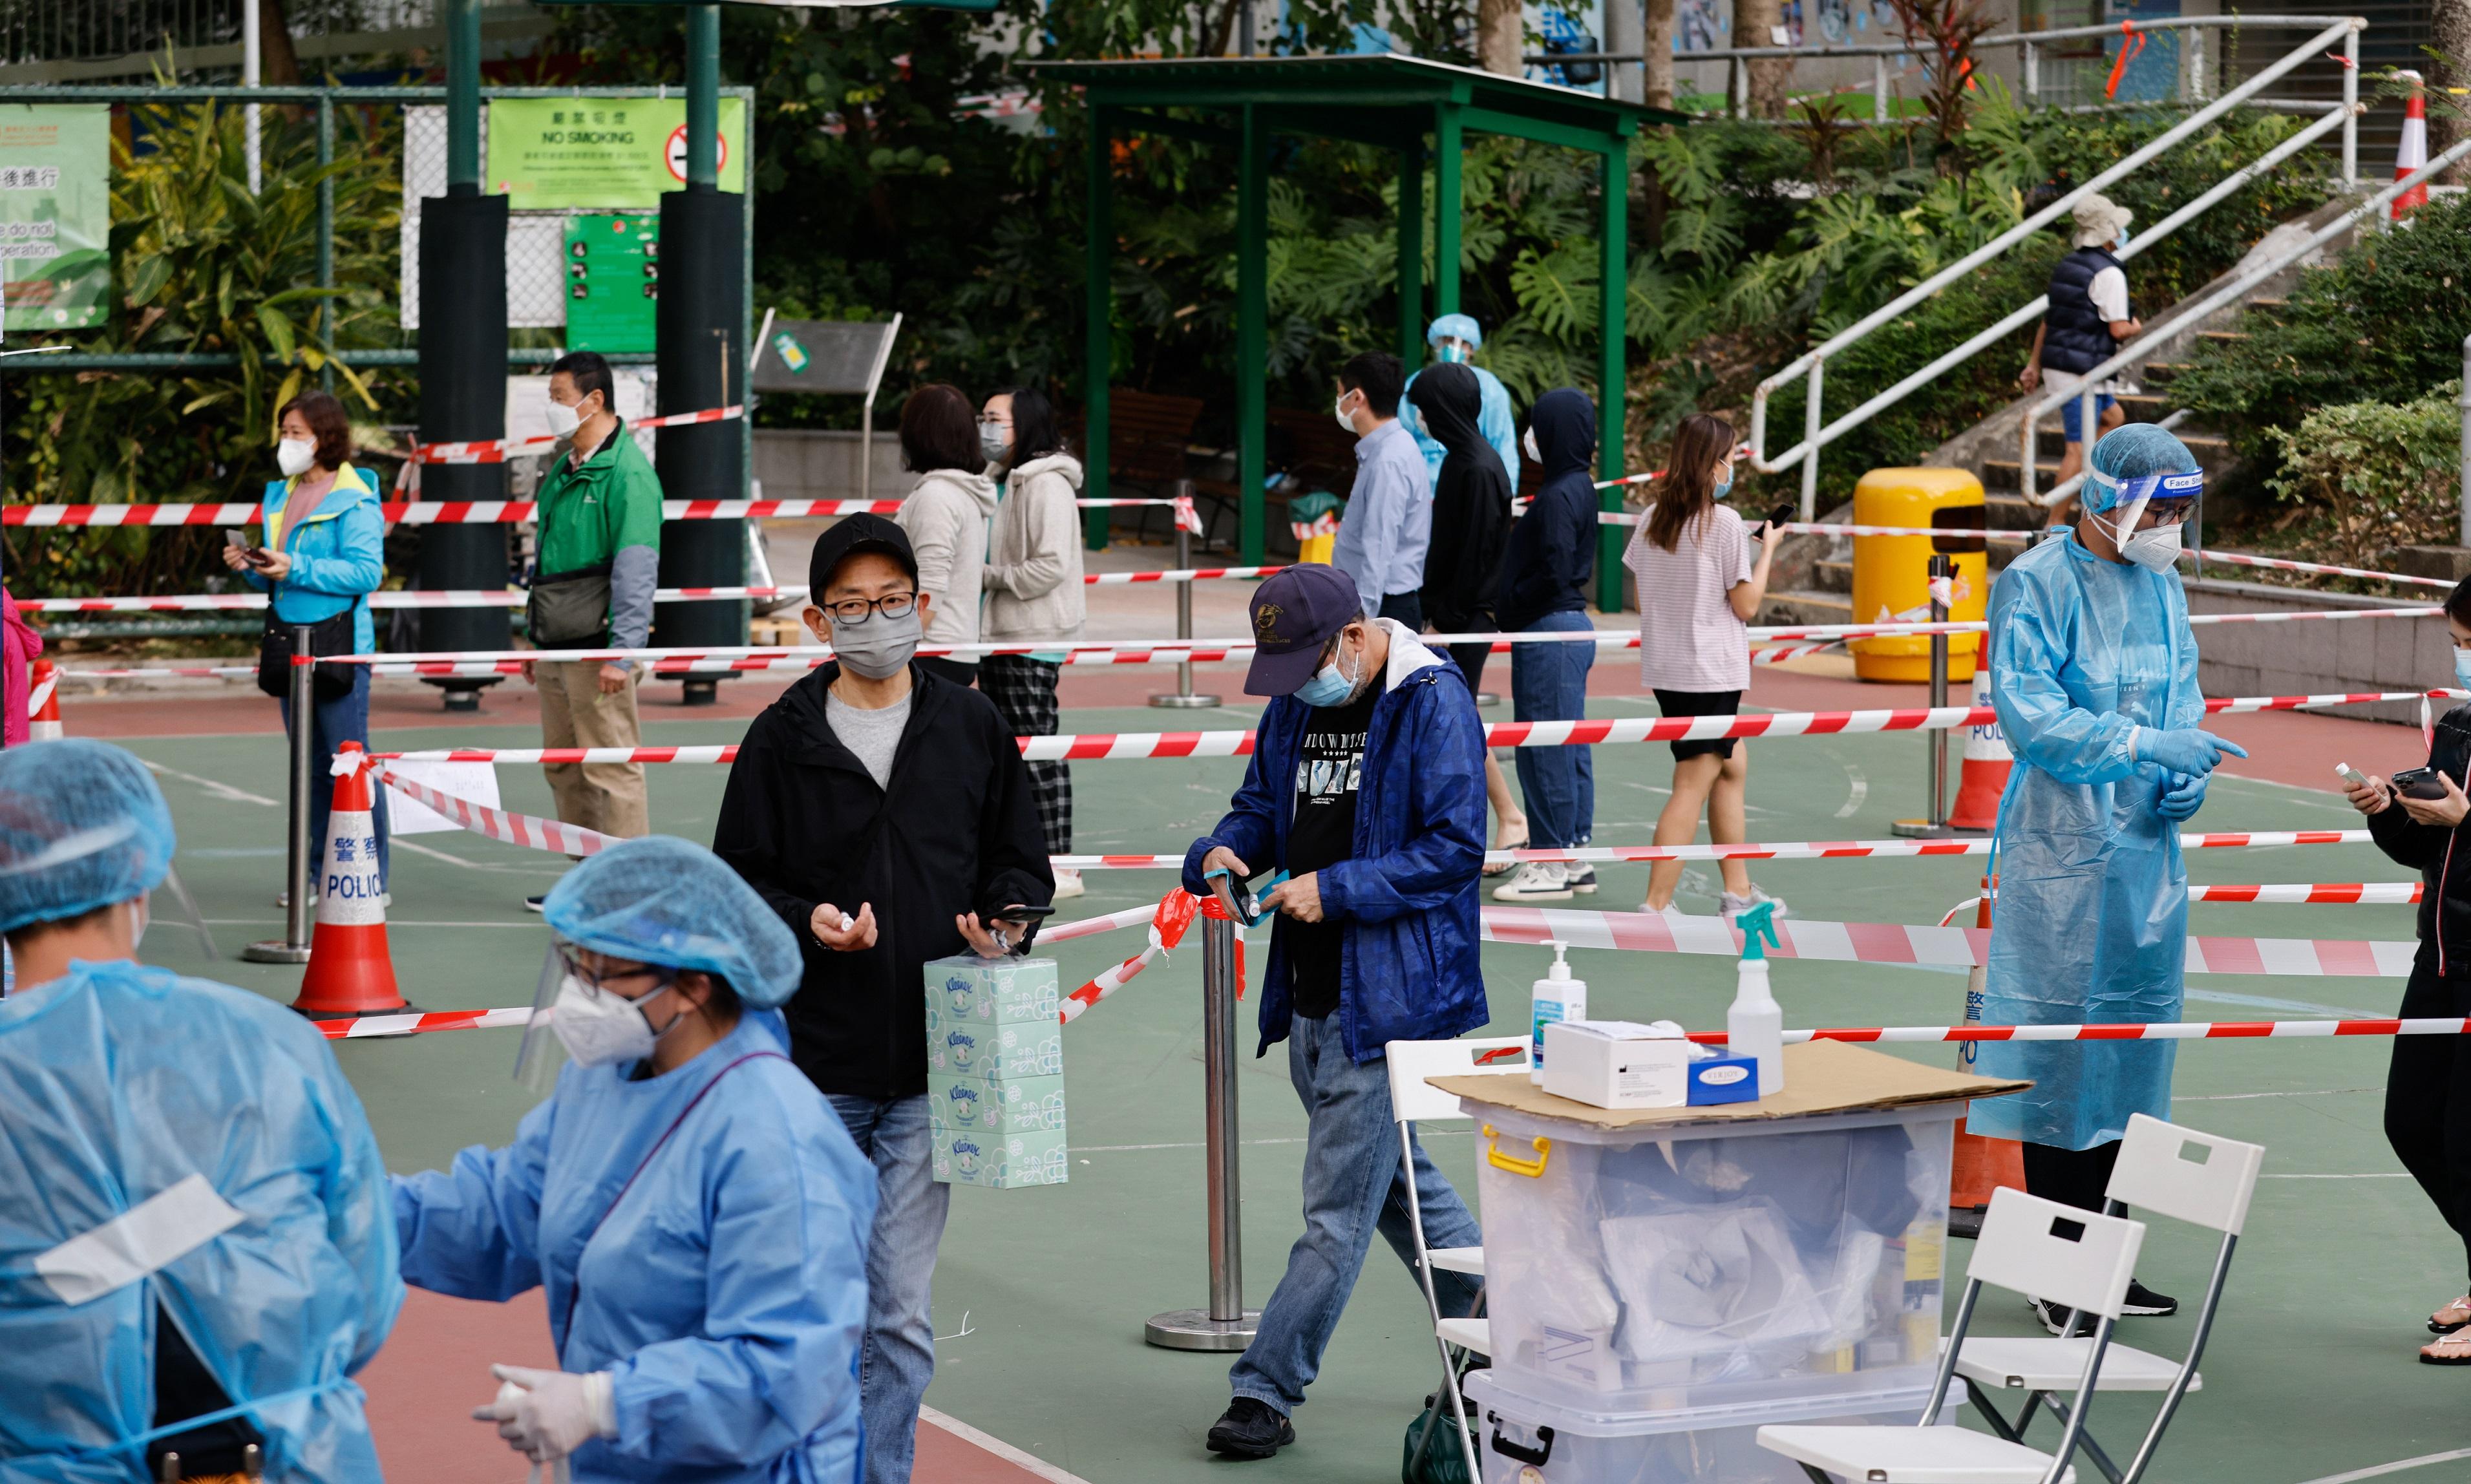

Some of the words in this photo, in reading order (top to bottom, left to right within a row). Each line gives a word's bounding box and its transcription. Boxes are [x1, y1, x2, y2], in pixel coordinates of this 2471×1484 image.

[542, 132, 564, 143] NO
[567, 131, 634, 144] SMOKING
[10, 224, 27, 235] do
[32, 222, 53, 235] not
[328, 874, 381, 898] POLIC
[946, 977, 973, 995] Kleenex
[1966, 990, 1984, 1021] 警
[947, 1030, 975, 1049] Kleenex
[949, 1085, 978, 1103] Kleenex
[952, 1138, 980, 1157] Kleenex
